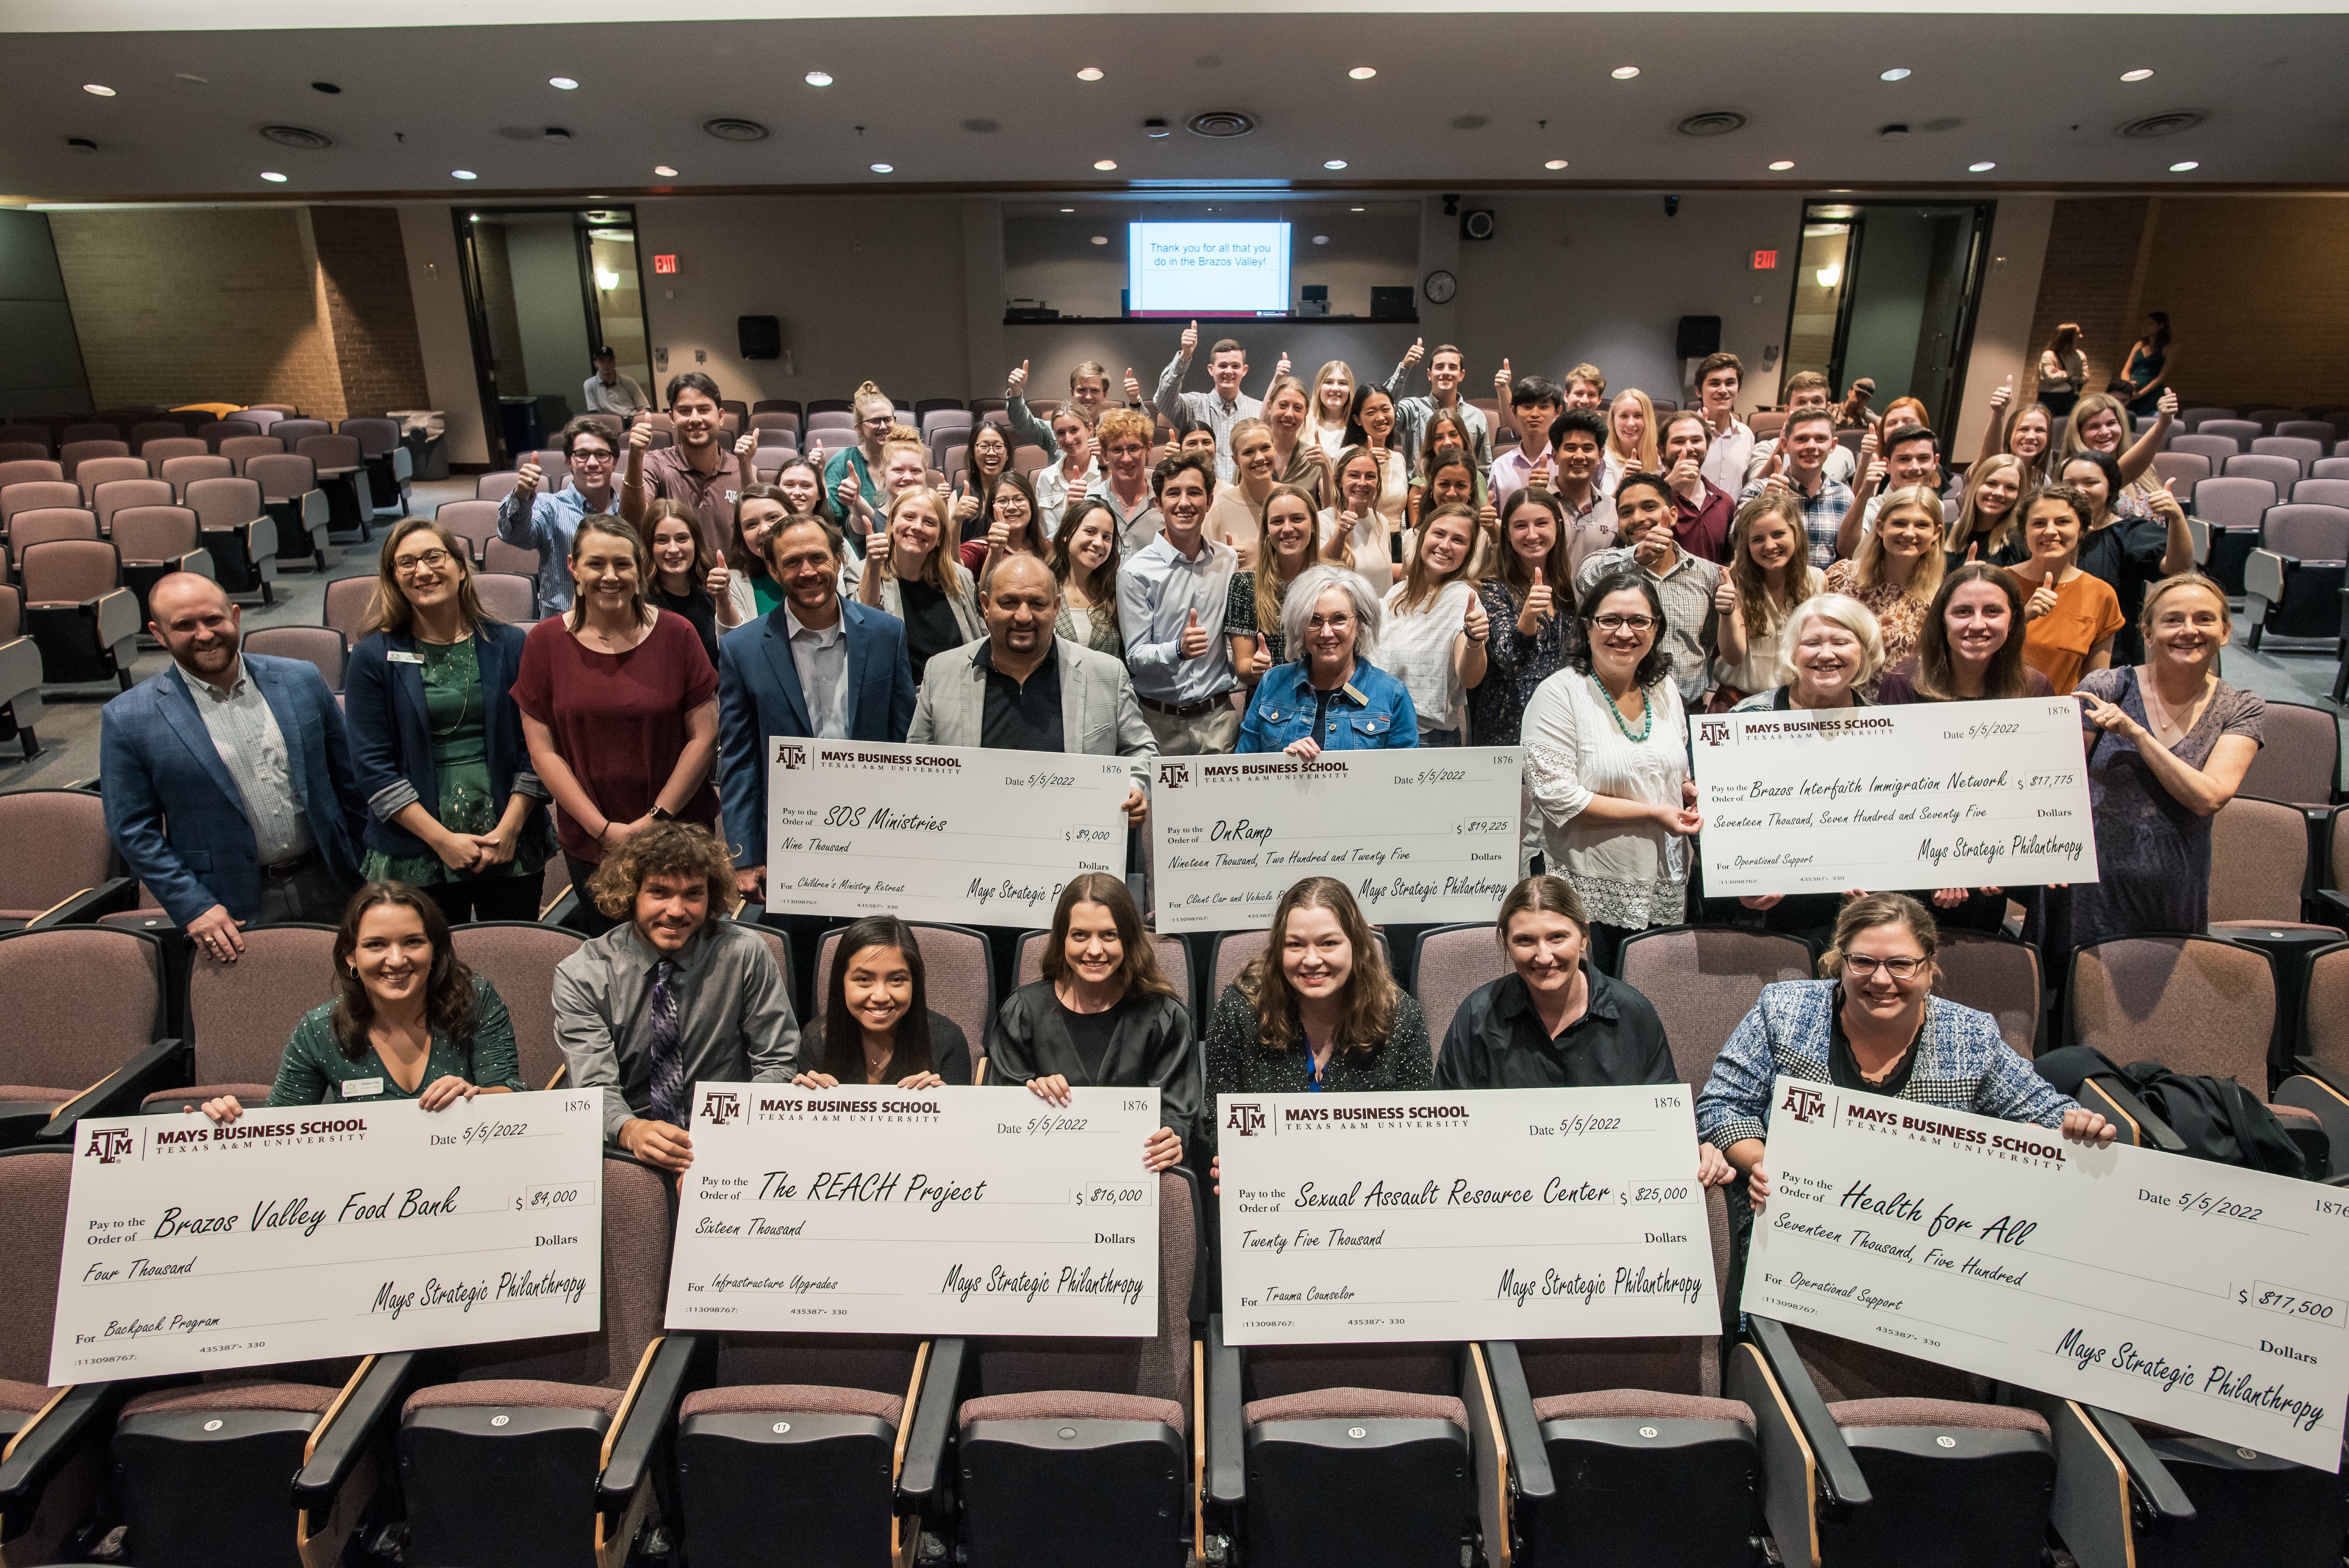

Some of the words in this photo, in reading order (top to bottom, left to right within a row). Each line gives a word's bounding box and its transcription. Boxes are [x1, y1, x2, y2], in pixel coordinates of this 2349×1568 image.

[1150, 243, 1180, 252] Thank
[1183, 245, 1199, 254] you
[1203, 243, 1215, 252] for
[1219, 243, 1230, 252] all
[1232, 243, 1250, 252] that
[1253, 245, 1271, 254] you
[654, 255, 676, 273] EXIT
[1154, 257, 1166, 266] do
[1169, 257, 1177, 266] in
[1181, 257, 1195, 266] the
[1199, 257, 1232, 266] Brazos
[1235, 257, 1266, 268] Valley!
[1754, 250, 1777, 269] EXIT
[1745, 723, 1780, 734] MAYS
[1783, 720, 1841, 732] BUSINESS
[1844, 718, 1894, 729] SCHOOL
[821, 751, 854, 762] MAYS
[857, 752, 912, 765] BUSINESS
[915, 756, 961, 767] SCHOOL
[1102, 764, 1121, 774] 1876
[1204, 765, 1239, 776] MAYS
[1242, 763, 1298, 774] BUSINESS
[1301, 761, 1349, 772] SCHOOL
[1394, 776, 1413, 784] Date
[1417, 768, 1465, 785] 5/5/2022
[1749, 780, 1793, 798] Brazos
[1799, 777, 1862, 800] Interfaith
[1869, 775, 1940, 797] Immigration
[1946, 770, 2007, 789] Network
[2030, 775, 2073, 788] $17,775
[823, 805, 866, 827] SOS
[867, 807, 947, 831] Ministries
[1713, 814, 1762, 828] Seventeen
[1768, 812, 1813, 827] Thousand,
[1819, 811, 1848, 823] Seven
[1853, 809, 1895, 823] Hundred
[1898, 808, 1916, 821] and
[1919, 806, 1960, 823] Seventy
[1965, 804, 1987, 817] Five
[1076, 829, 1110, 841] $9,000
[1210, 819, 1273, 847] OnRamp
[1467, 821, 1508, 833] $19,225
[781, 836, 803, 850] Nine
[808, 838, 852, 853] Thousand
[1917, 837, 1948, 866] Mays
[1953, 837, 2005, 864] Strategic
[2011, 834, 2083, 861] Philanthropy
[1167, 855, 1210, 869] Nineteen
[1215, 853, 1259, 867] Thousand,
[1265, 851, 1284, 865] Two
[1288, 850, 1330, 864] Hundred
[1331, 850, 1347, 862] and
[1351, 848, 1386, 865] Twenty
[1390, 847, 1410, 860] Five
[1734, 854, 1780, 869] Operational
[1782, 853, 1813, 868] Support
[797, 877, 836, 889] Children's
[838, 879, 871, 894] Ministry
[874, 881, 905, 892] Retreat
[1186, 894, 1210, 905] Client
[1212, 893, 1227, 903] Car
[1230, 892, 1243, 902] and
[1246, 891, 1273, 902] Vehicle
[565, 1099, 590, 1112] 1876
[759, 1099, 803, 1112] MAYS
[807, 1100, 877, 1112] BUSINESS
[881, 1101, 941, 1113] SCHOOL
[1123, 1100, 1148, 1111] 1876
[1285, 1108, 1329, 1121] MAYS
[1333, 1107, 1404, 1120] BUSINESS
[1408, 1105, 1469, 1119] SCHOOL
[157, 1129, 208, 1144] MAYS
[213, 1123, 295, 1140] BUSINESS
[300, 1118, 367, 1135] SCHOOL
[1378, 1120, 1468, 1128] UNIVERSITY
[1529, 1125, 1554, 1135] Date
[1559, 1114, 1620, 1137] 5/5/2022
[1847, 1104, 1897, 1126] MAYS
[1902, 1115, 1987, 1144] BUSINESS
[1991, 1135, 2066, 1162] SCHOOL
[701, 1176, 719, 1188] Pay
[733, 1177, 748, 1186] the
[531, 1189, 577, 1207] $4,000
[700, 1190, 728, 1199] Order
[730, 1191, 741, 1200] of
[758, 1171, 797, 1200] The
[807, 1171, 901, 1202] REACH
[904, 1173, 987, 1212] Project
[1090, 1187, 1142, 1205] $16,000
[1294, 1181, 1366, 1207] Sexual
[1363, 1179, 1440, 1207] Assault
[1447, 1178, 1533, 1205] Resource
[1543, 1176, 1610, 1203] Center
[1635, 1187, 1687, 1203] $25,000
[153, 1206, 239, 1239] Brazos
[251, 1197, 326, 1237] Valley
[337, 1192, 393, 1222] Food
[397, 1185, 460, 1219] Bank
[1839, 1180, 1924, 1221] Health
[1927, 1203, 1973, 1237] for
[1979, 1215, 2037, 1246] All
[2137, 1188, 2171, 1206] Date
[2178, 1192, 2262, 1224] 5/5/2022
[695, 1216, 741, 1235] Sixteen
[747, 1217, 806, 1236] Thousand
[534, 1234, 577, 1246] Dollars
[1242, 1229, 1288, 1254] Twenty
[1294, 1229, 1320, 1247] Five
[1328, 1228, 1385, 1247] Thousand
[1774, 1212, 1842, 1242] Seventeen
[1850, 1229, 1917, 1263] Thousand,
[1923, 1248, 1954, 1268] Five
[1960, 1256, 2028, 1286] Hundred
[83, 1262, 119, 1282] Four
[128, 1255, 198, 1279] Thousand
[711, 1273, 784, 1292] Infrastructure
[789, 1274, 838, 1294] Upgrades
[1790, 1271, 1856, 1297] Operational
[1857, 1288, 1903, 1310] Support
[371, 1280, 415, 1320] Mays
[420, 1278, 488, 1313] Strategic
[495, 1269, 586, 1304] Philanthropy
[1266, 1286, 1301, 1302] Trauma
[1306, 1285, 1355, 1301] Counselor
[2258, 1290, 2333, 1318] $17,500
[103, 1316, 166, 1339] Backpack
[169, 1314, 220, 1334] Program
[2055, 1327, 2106, 1370] Mays
[2111, 1342, 2194, 1392] Strategic
[2202, 1365, 2324, 1431] Philanthropy
